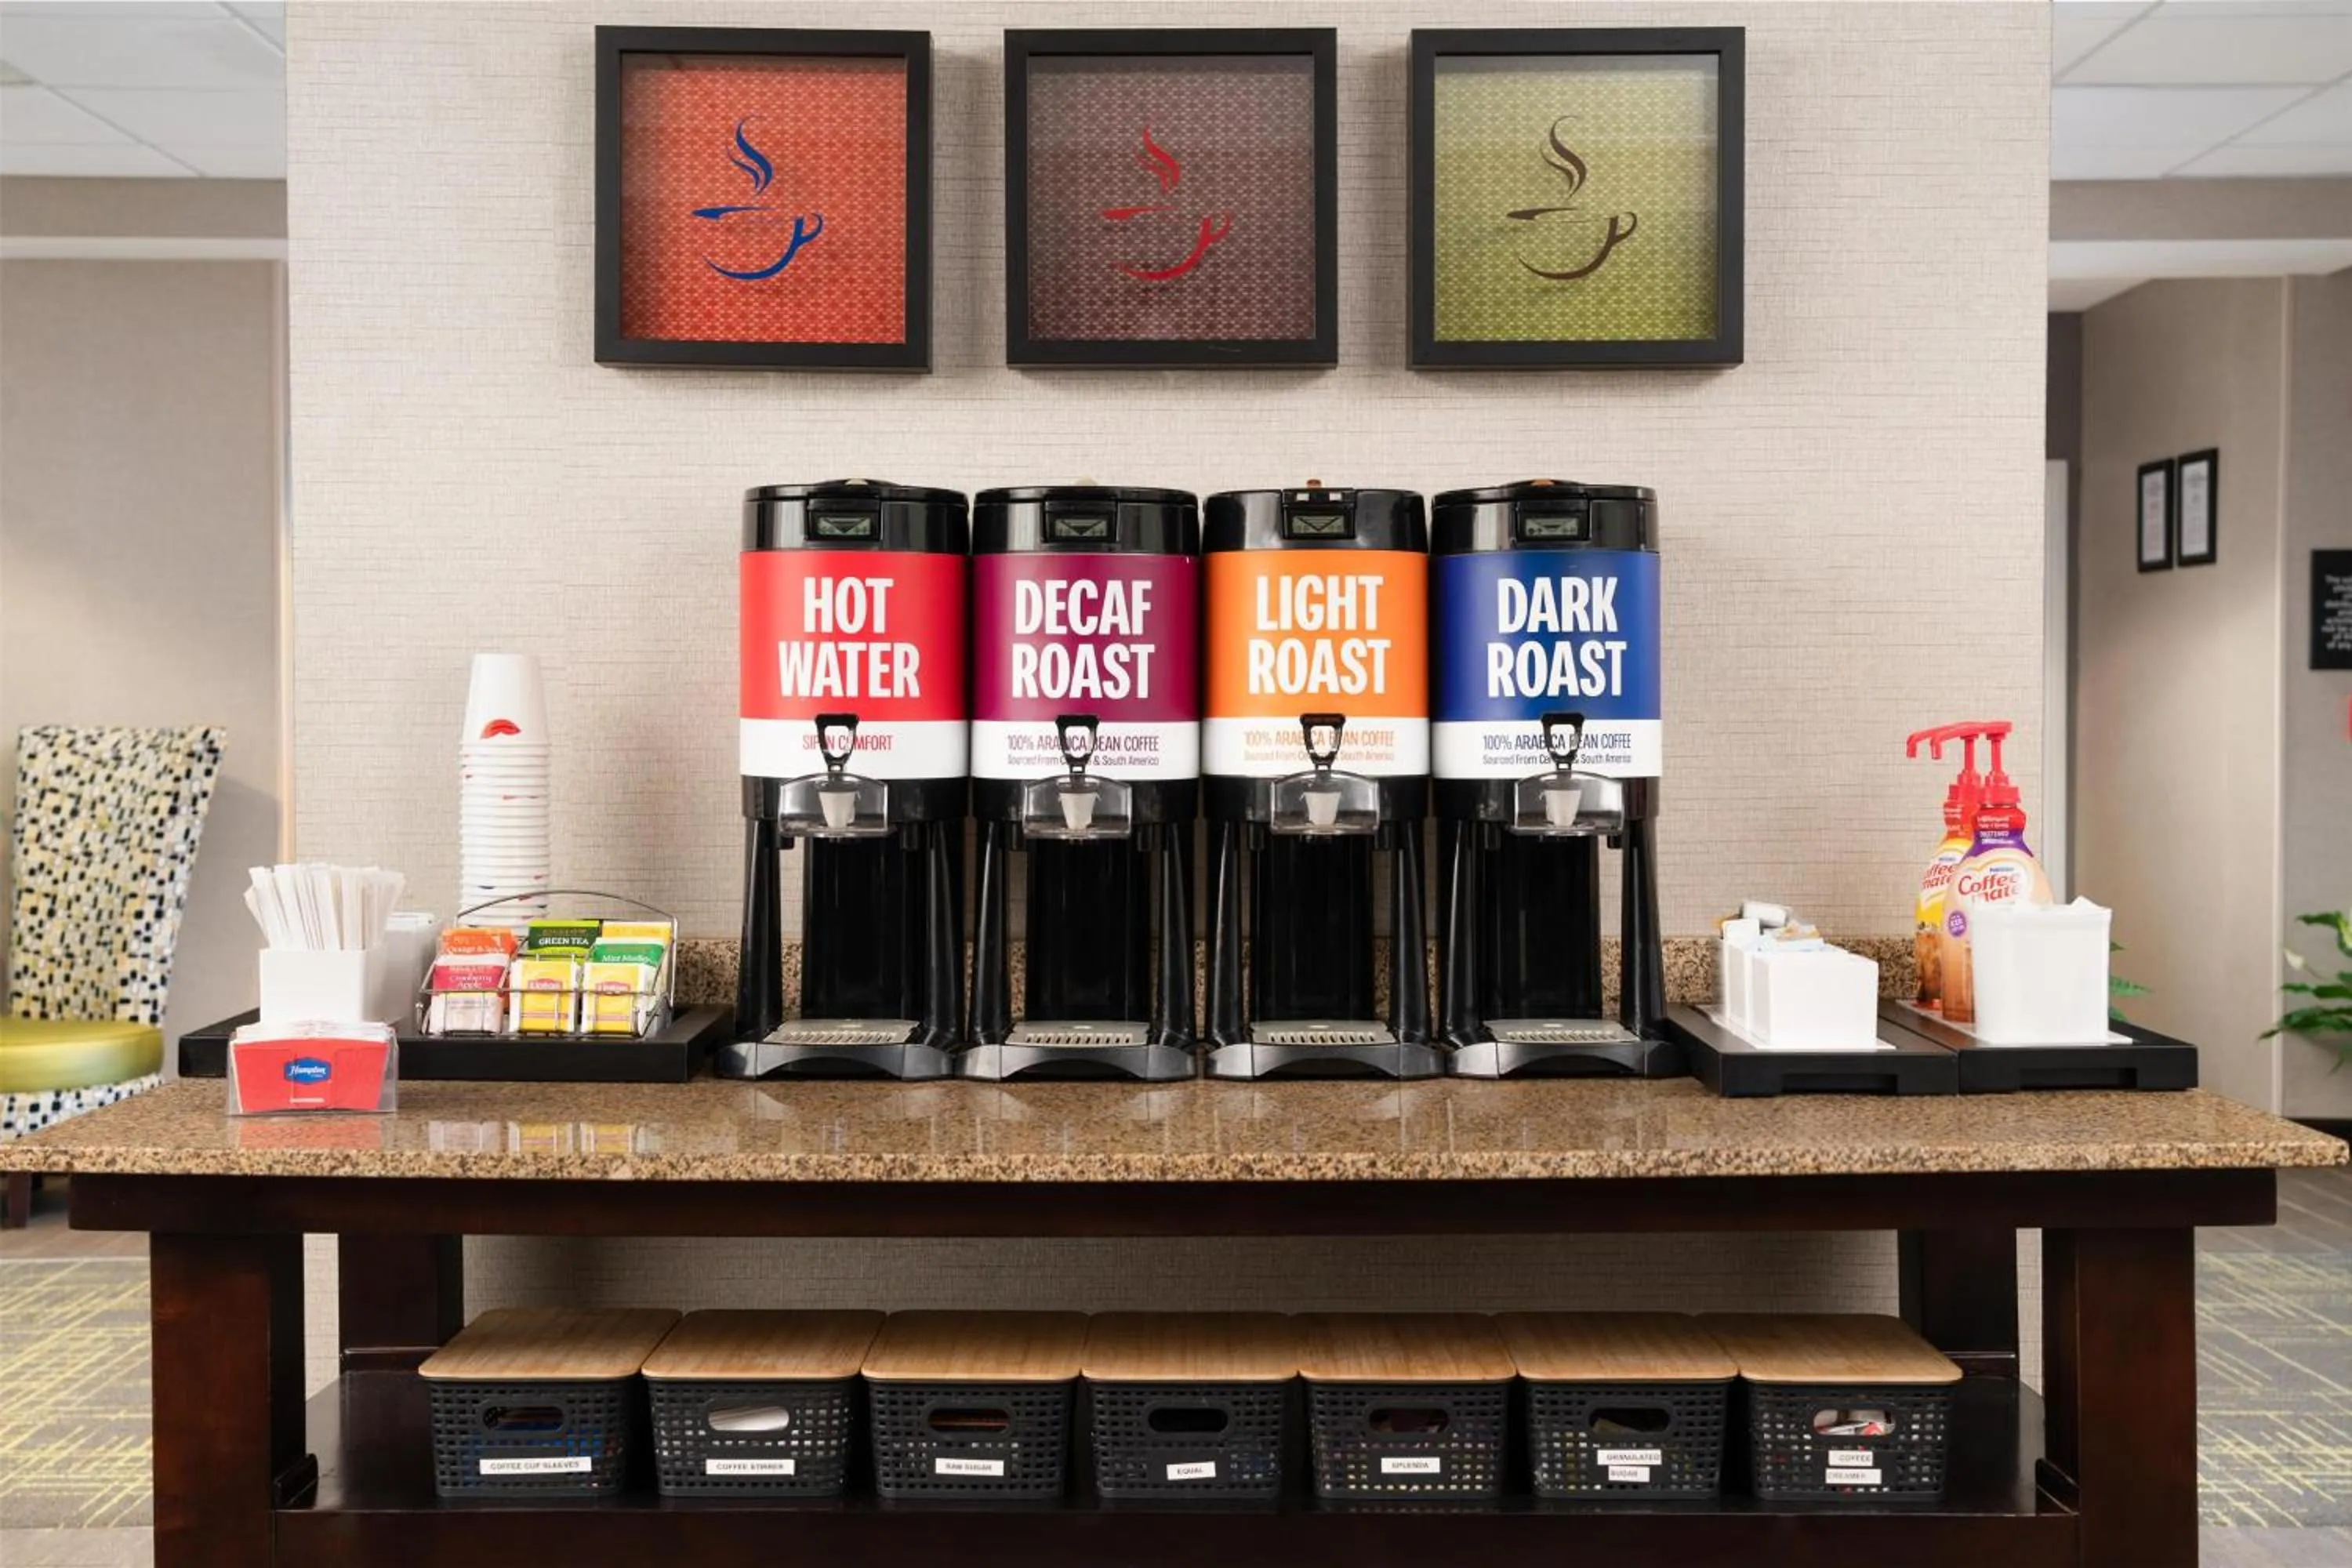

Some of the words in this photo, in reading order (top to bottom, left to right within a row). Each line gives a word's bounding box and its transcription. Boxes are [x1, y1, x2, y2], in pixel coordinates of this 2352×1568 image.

[804, 577, 893, 633] HOT
[1014, 579, 1152, 635] DECAF
[1256, 575, 1383, 631] LIGHT
[1497, 577, 1617, 633] DARK
[779, 641, 920, 698] WATER
[1011, 643, 1155, 699] ROAST
[1248, 638, 1391, 695] ROAST
[1486, 641, 1627, 698] ROAST
[1008, 735, 1035, 750] 100%
[1037, 735, 1087, 751] ARAICA
[1123, 735, 1160, 751] COFFEE
[1276, 730, 1325, 746] ARABCA
[1330, 730, 1358, 746] BAN
[1483, 734, 1512, 750] 100%
[1515, 734, 1566, 750] ARABCA
[1601, 734, 1632, 749] COFFEE
[1958, 873, 2020, 895] Coffee
[539, 936, 570, 945] GREEN
[571, 936, 590, 946] TEA
[489, 1461, 521, 1471] COFFEE
